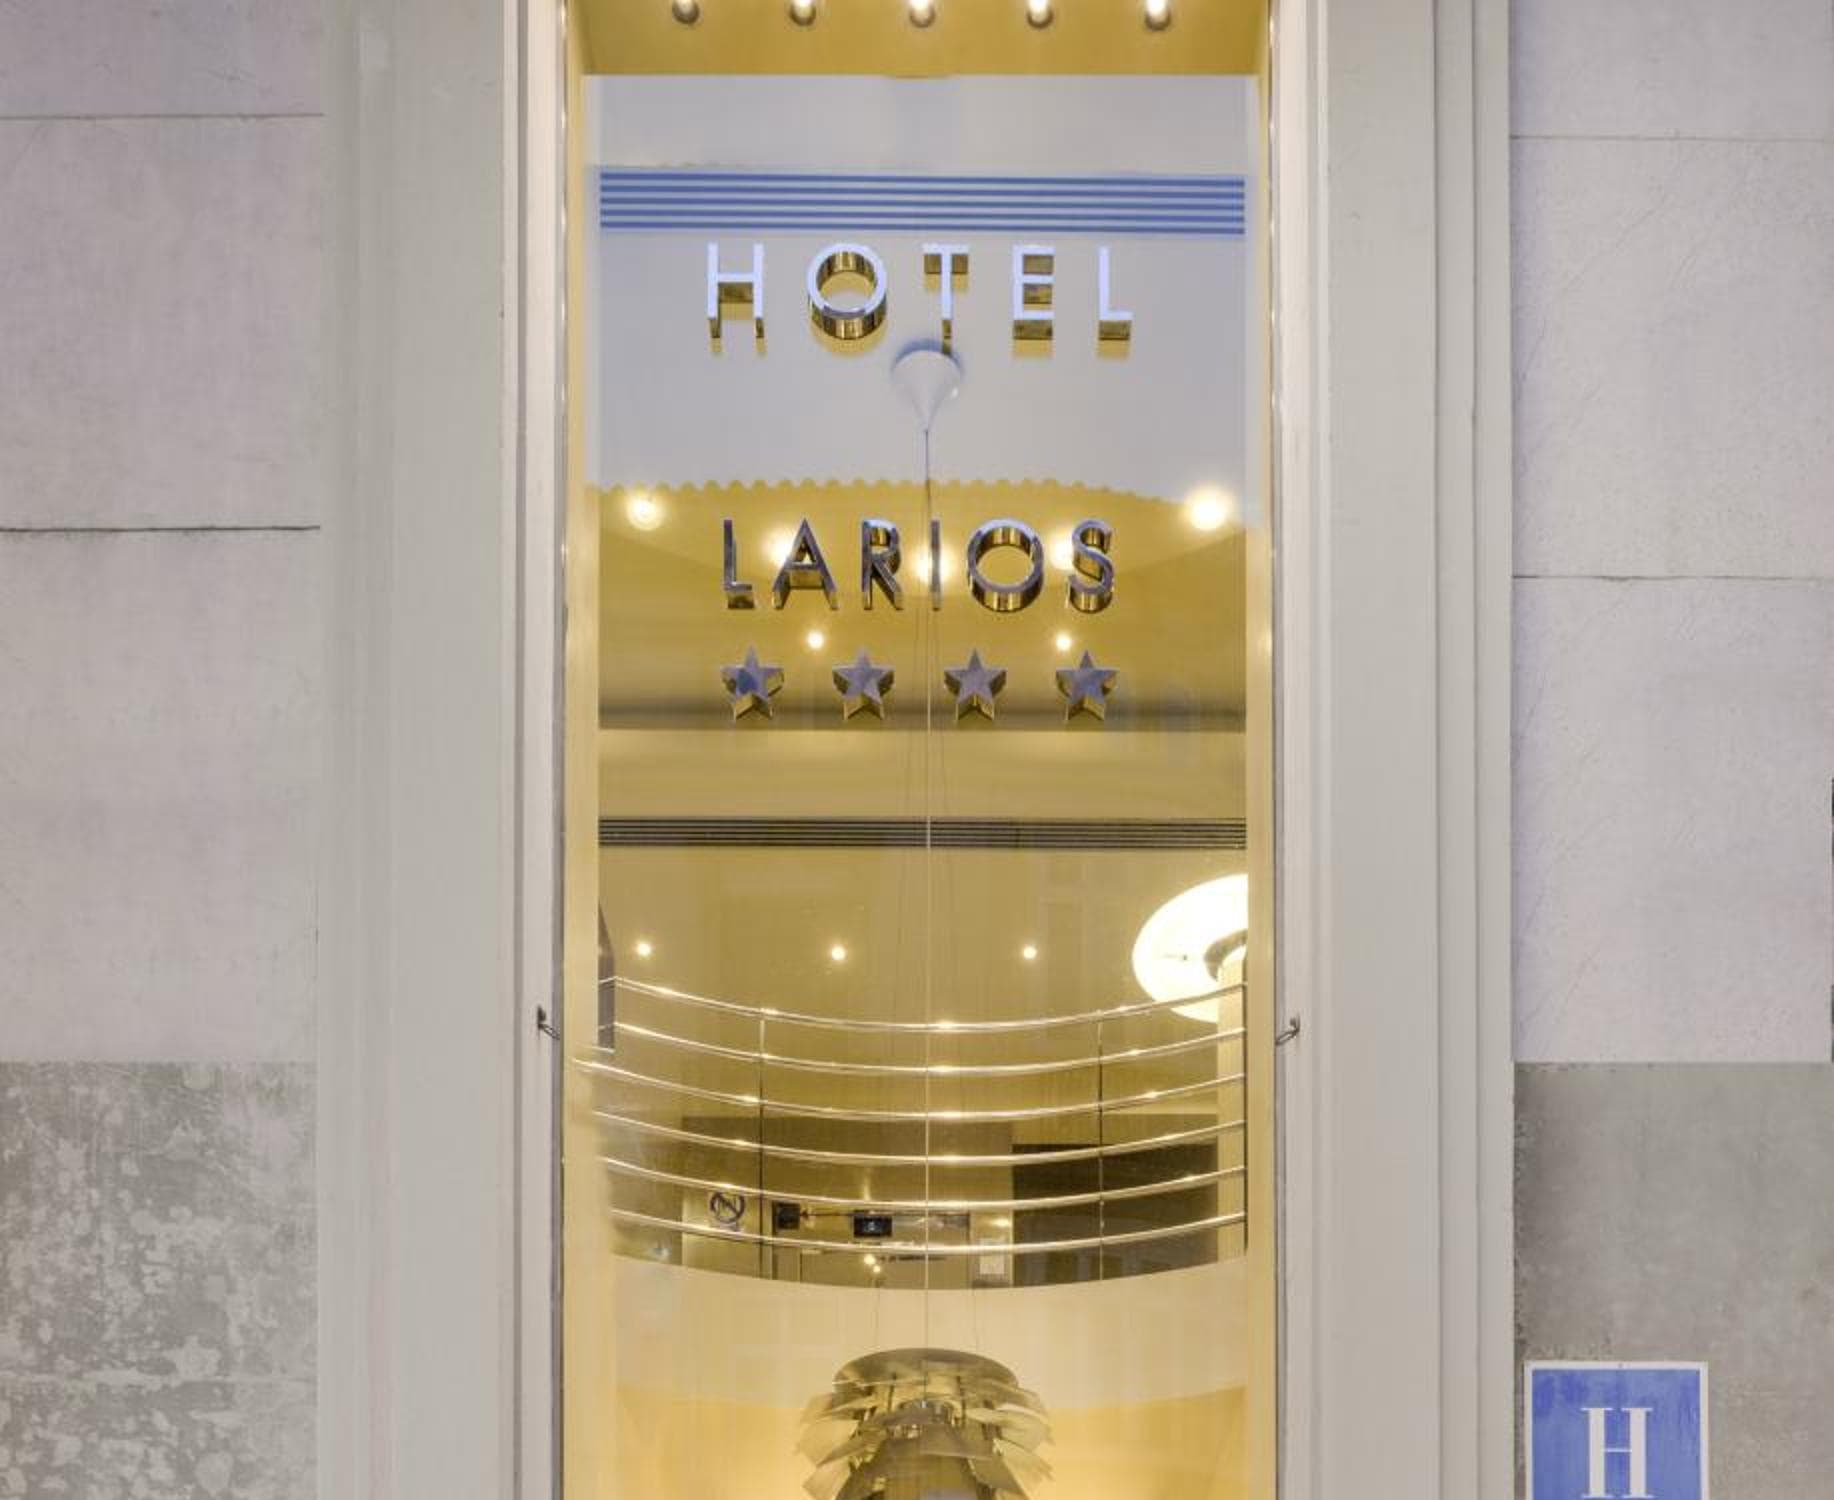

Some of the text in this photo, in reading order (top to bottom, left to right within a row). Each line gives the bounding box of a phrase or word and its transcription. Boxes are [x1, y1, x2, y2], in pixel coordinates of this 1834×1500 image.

[706, 243, 1134, 346] HOTEL
[722, 517, 1116, 614] LARIOS
[1581, 1407, 1655, 1500] H
